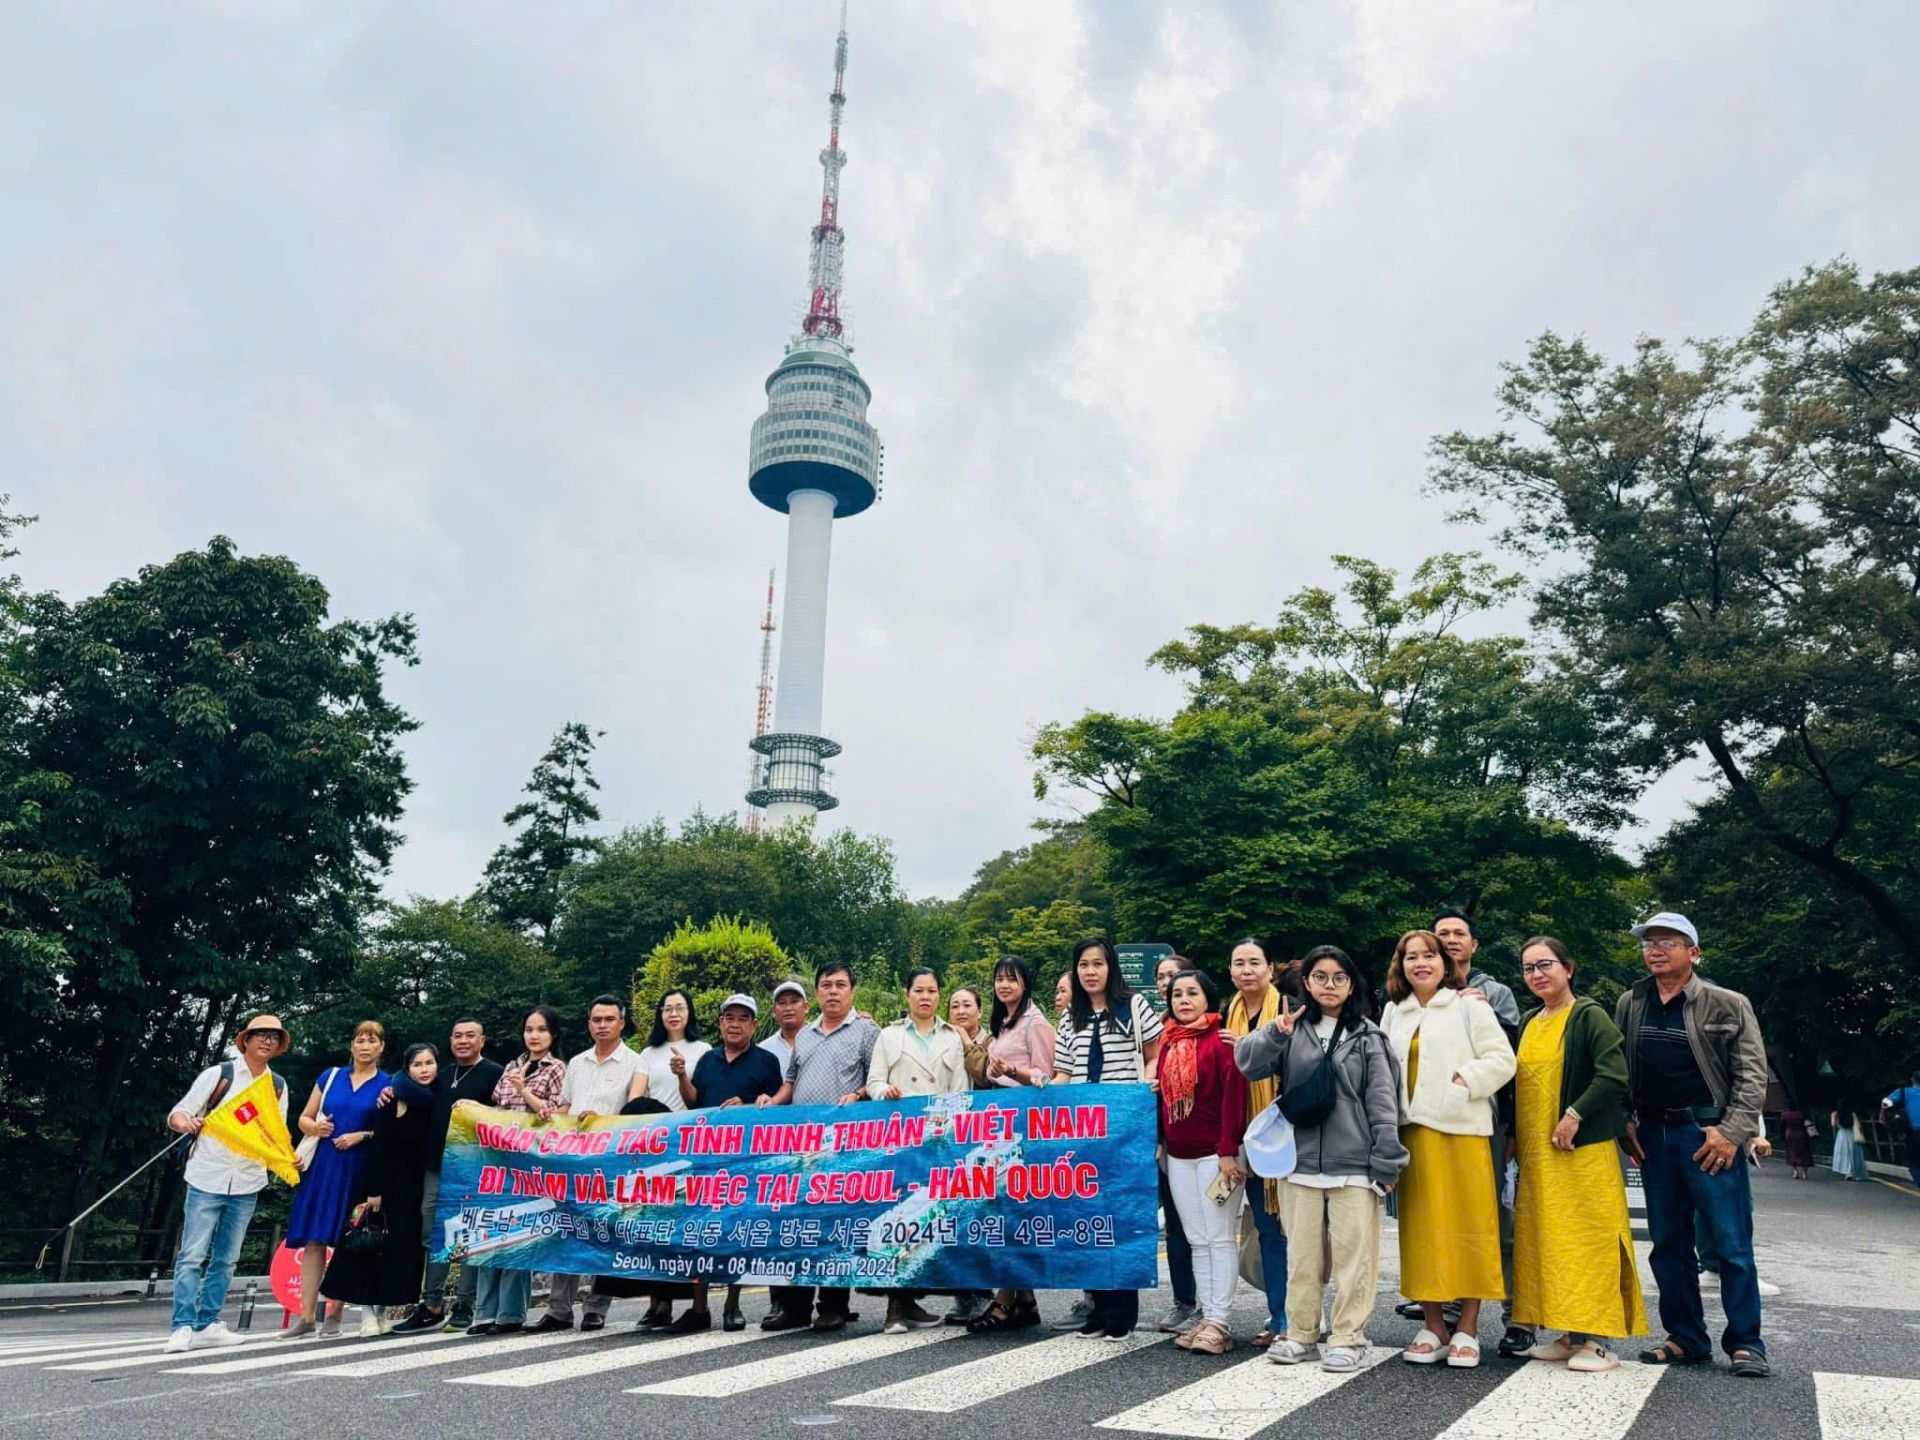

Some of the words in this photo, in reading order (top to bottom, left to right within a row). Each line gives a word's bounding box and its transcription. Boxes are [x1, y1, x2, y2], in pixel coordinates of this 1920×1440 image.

[540, 1128, 613, 1155] CÔNG
[616, 1124, 669, 1155] TÁC
[678, 1116, 744, 1155] TỈNH
[750, 1123, 825, 1155] NINH
[833, 1112, 927, 1155] THUẬN
[933, 1128, 945, 1136] -
[954, 1103, 1019, 1150] VIỆT
[1028, 1105, 1108, 1140] NAM
[478, 1166, 507, 1194] ĐI
[511, 1165, 567, 1202] THĂM
[574, 1168, 608, 1204] VÀ
[615, 1170, 676, 1206] LÀM
[685, 1169, 749, 1212] VIỆC
[756, 1173, 800, 1211] TẠI
[806, 1170, 901, 1204] SEOUL
[908, 1182, 920, 1191] -
[929, 1159, 996, 1200] HÀN
[1007, 1151, 1099, 1203] QUỐC
[461, 1207, 515, 1233] 베트남
[615, 1218, 676, 1245] 대표단
[682, 1219, 722, 1247] 일동
[728, 1219, 772, 1247] 서울
[780, 1218, 821, 1247] 방문
[828, 1218, 872, 1247] 서울
[881, 1218, 958, 1246] 2024년
[968, 1216, 1005, 1247] 9월
[1015, 1215, 1115, 1247] 4일~8일
[612, 1251, 655, 1272] Seoul,
[660, 1255, 693, 1276] ngày
[697, 1256, 714, 1274] 04
[728, 1257, 747, 1275] 08
[751, 1256, 795, 1279] tháng
[801, 1258, 811, 1276] 9
[816, 1257, 851, 1276] năm
[856, 1257, 897, 1277] 2024
